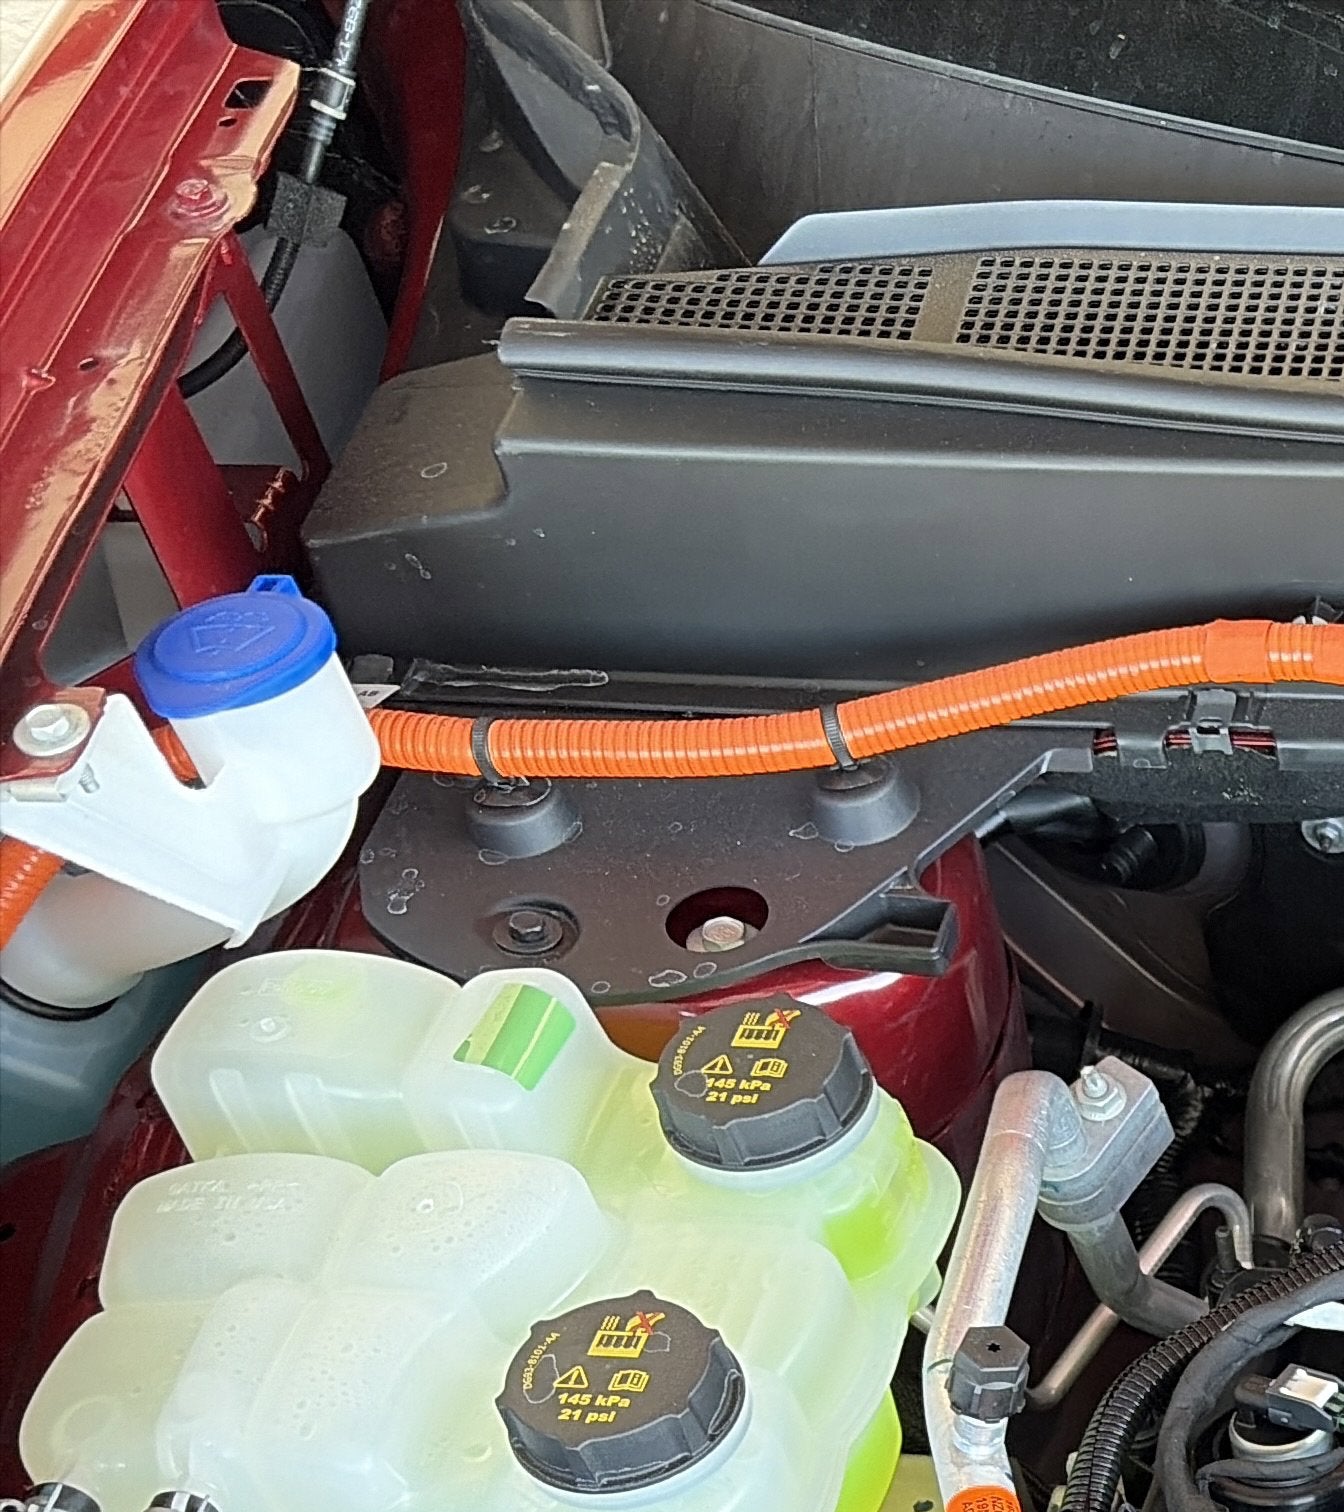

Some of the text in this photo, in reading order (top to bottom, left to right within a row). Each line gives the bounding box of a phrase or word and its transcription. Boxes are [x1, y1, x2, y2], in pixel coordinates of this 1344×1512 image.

[706, 1077, 772, 1092] 145 kPa
[705, 1091, 760, 1105] 21 psi
[557, 1393, 632, 1407] 145 kPa
[557, 1409, 616, 1424] 21 psi
